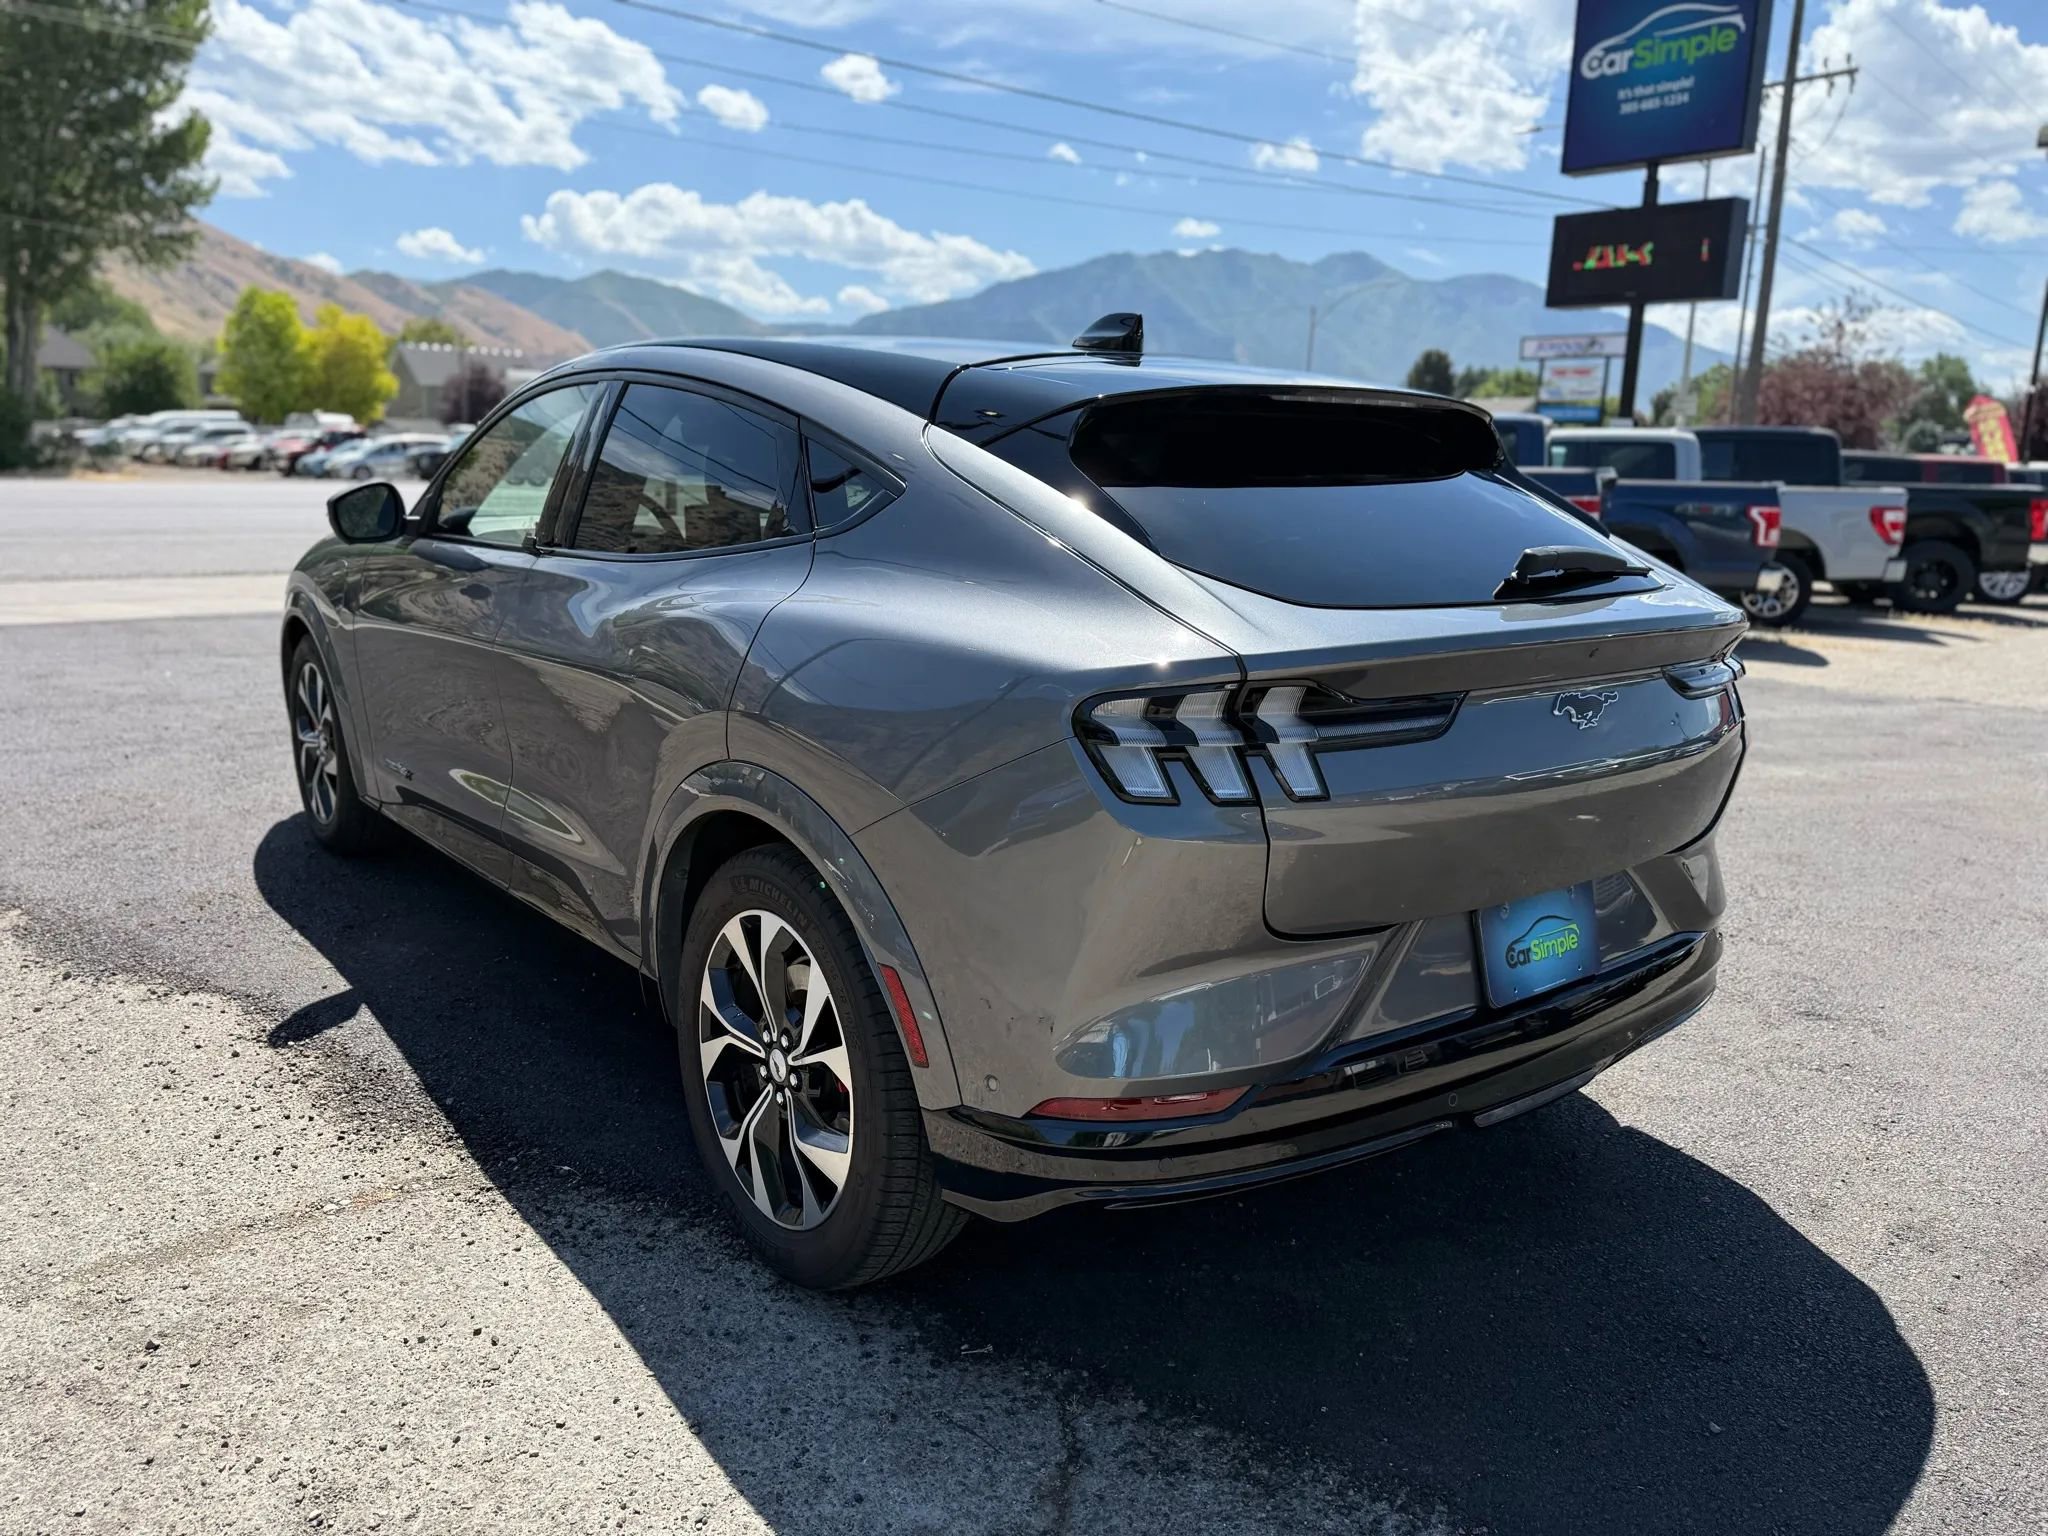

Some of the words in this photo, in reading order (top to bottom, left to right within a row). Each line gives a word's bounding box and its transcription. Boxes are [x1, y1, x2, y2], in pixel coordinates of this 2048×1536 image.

[1580, 26, 1738, 79] CarSimple
[748, 877, 808, 928] MICHELIN
[1505, 930, 1579, 969] CarSimple
